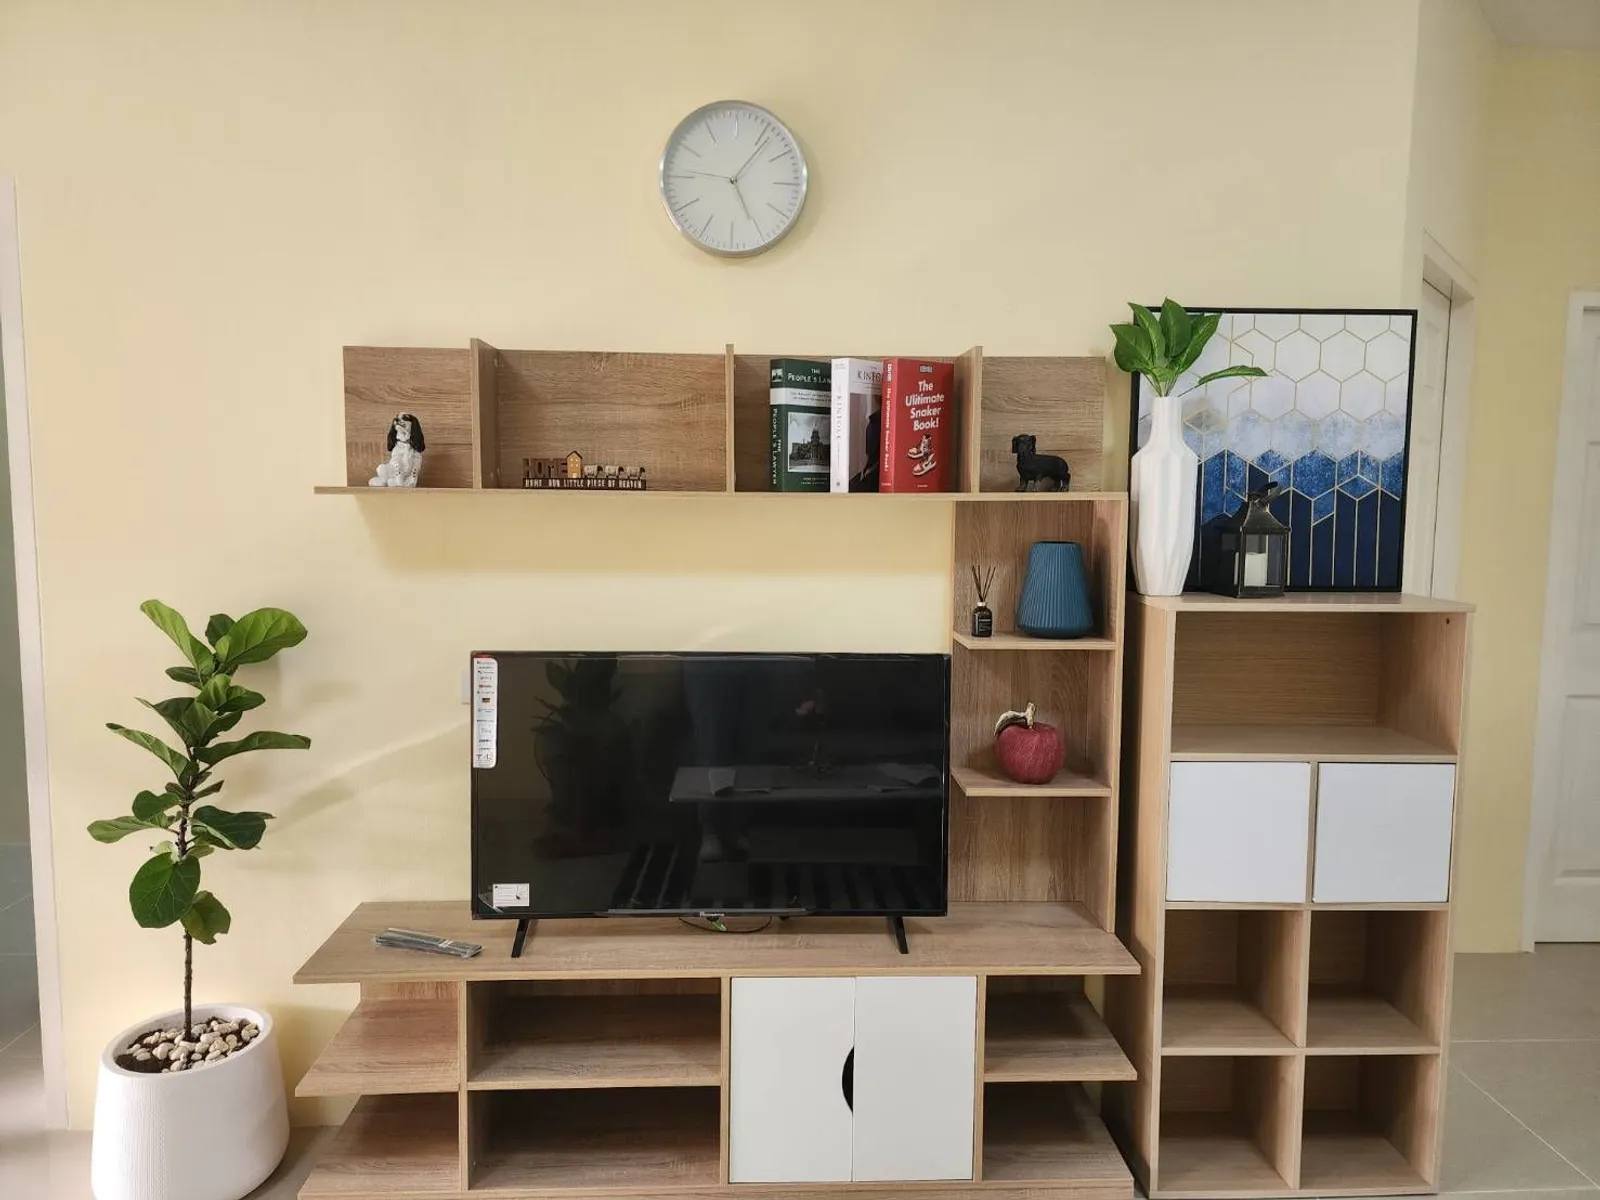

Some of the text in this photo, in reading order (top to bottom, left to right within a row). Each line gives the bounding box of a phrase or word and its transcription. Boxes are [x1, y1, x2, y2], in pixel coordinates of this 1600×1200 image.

[787, 373, 817, 383] PEOPLE'S
[918, 380, 933, 392] The
[905, 393, 945, 407] Ulitimate
[910, 404, 942, 419] Snaker
[913, 417, 939, 432] Book!
[563, 479, 583, 487] LITTLE
[587, 479, 605, 487] PIECE
[608, 479, 615, 488] OF
[618, 480, 642, 489] HEAVEN
